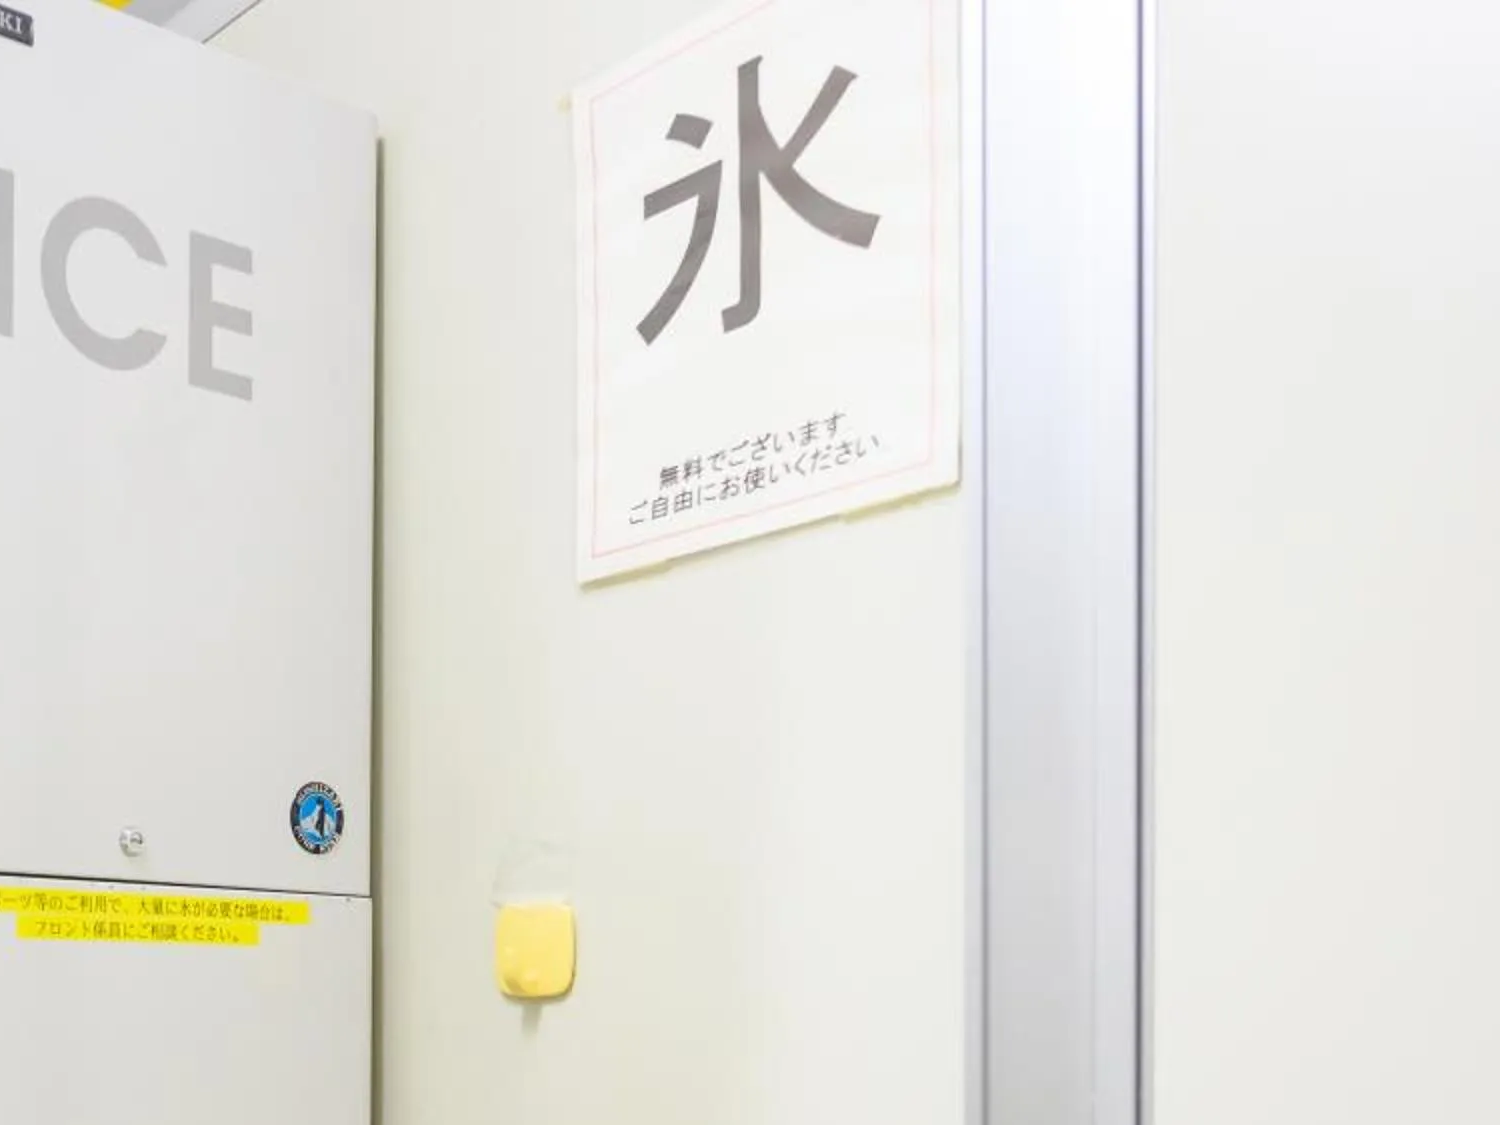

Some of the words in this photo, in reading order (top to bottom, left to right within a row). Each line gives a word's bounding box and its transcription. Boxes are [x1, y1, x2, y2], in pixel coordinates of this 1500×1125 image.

[636, 55, 882, 347] 氷
[628, 434, 880, 525] ご自由にお使いください
[659, 411, 847, 490] 無料でございます
